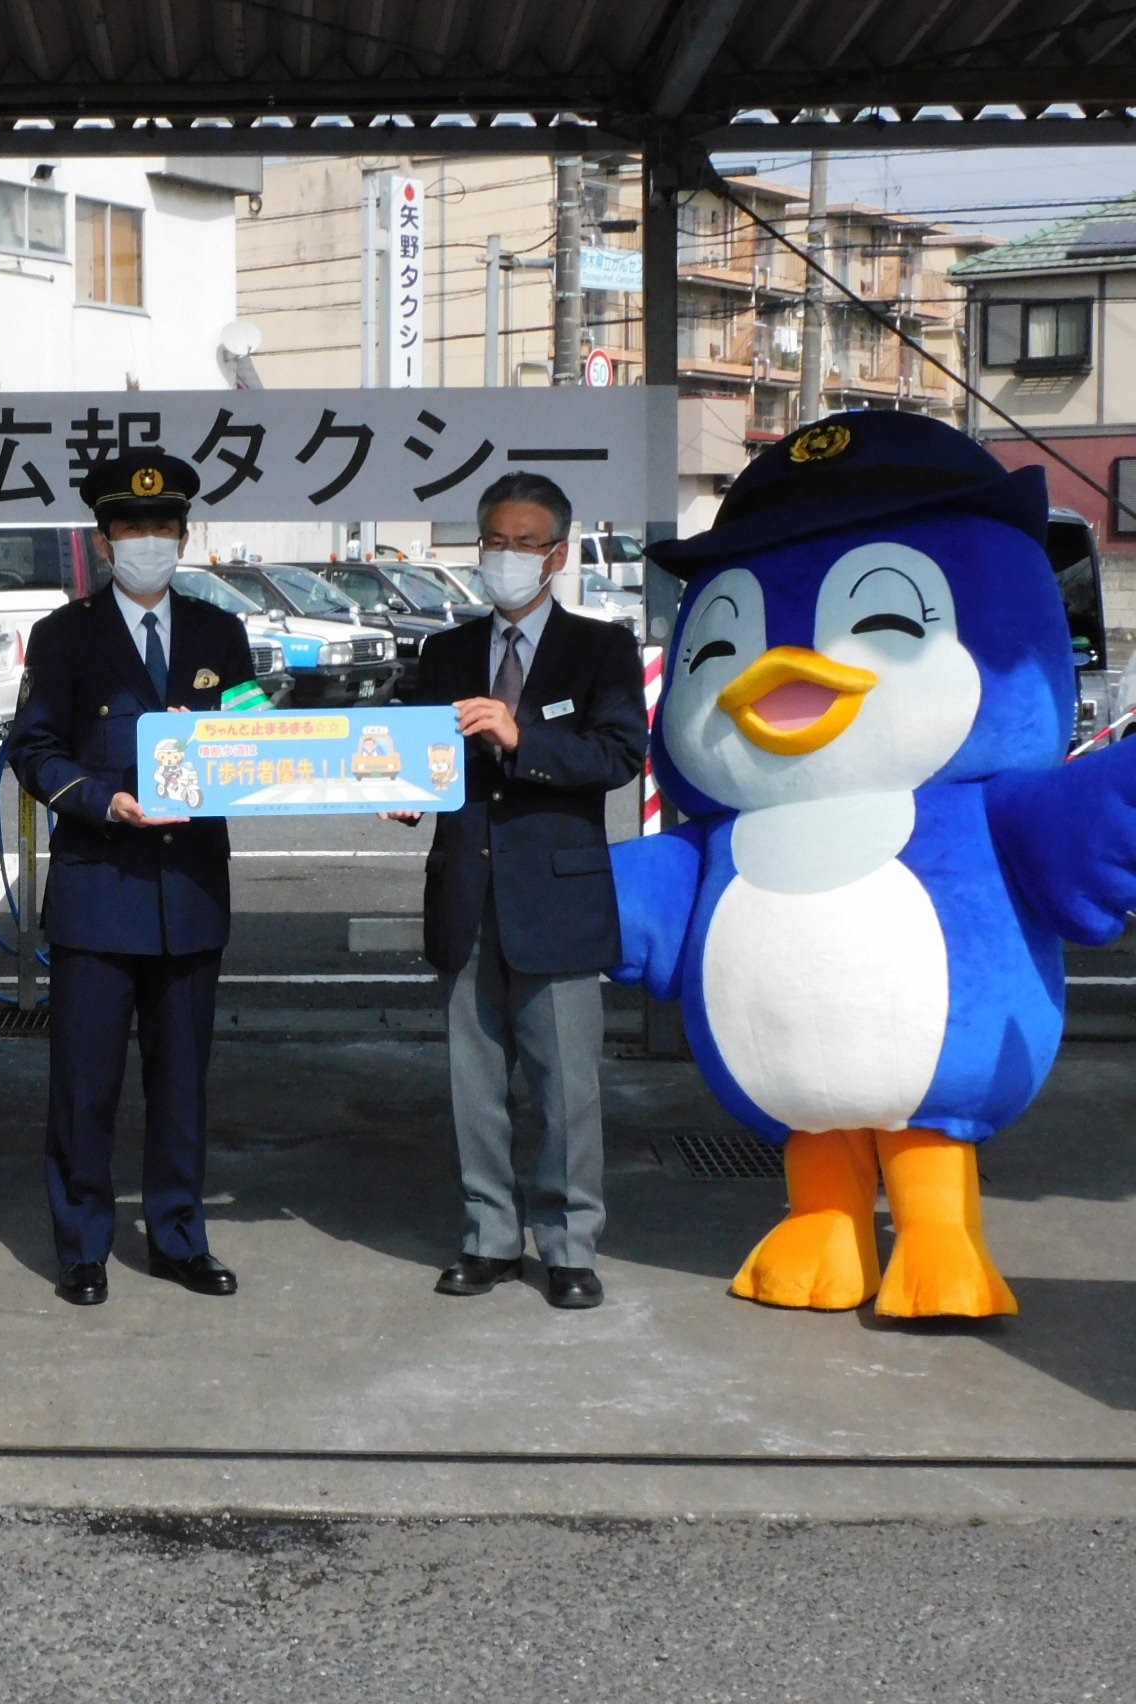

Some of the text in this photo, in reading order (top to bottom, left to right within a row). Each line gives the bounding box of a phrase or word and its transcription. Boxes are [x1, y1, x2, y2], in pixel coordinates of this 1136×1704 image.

[399, 203, 420, 378] 矢野タクシー
[592, 361, 607, 384] 50
